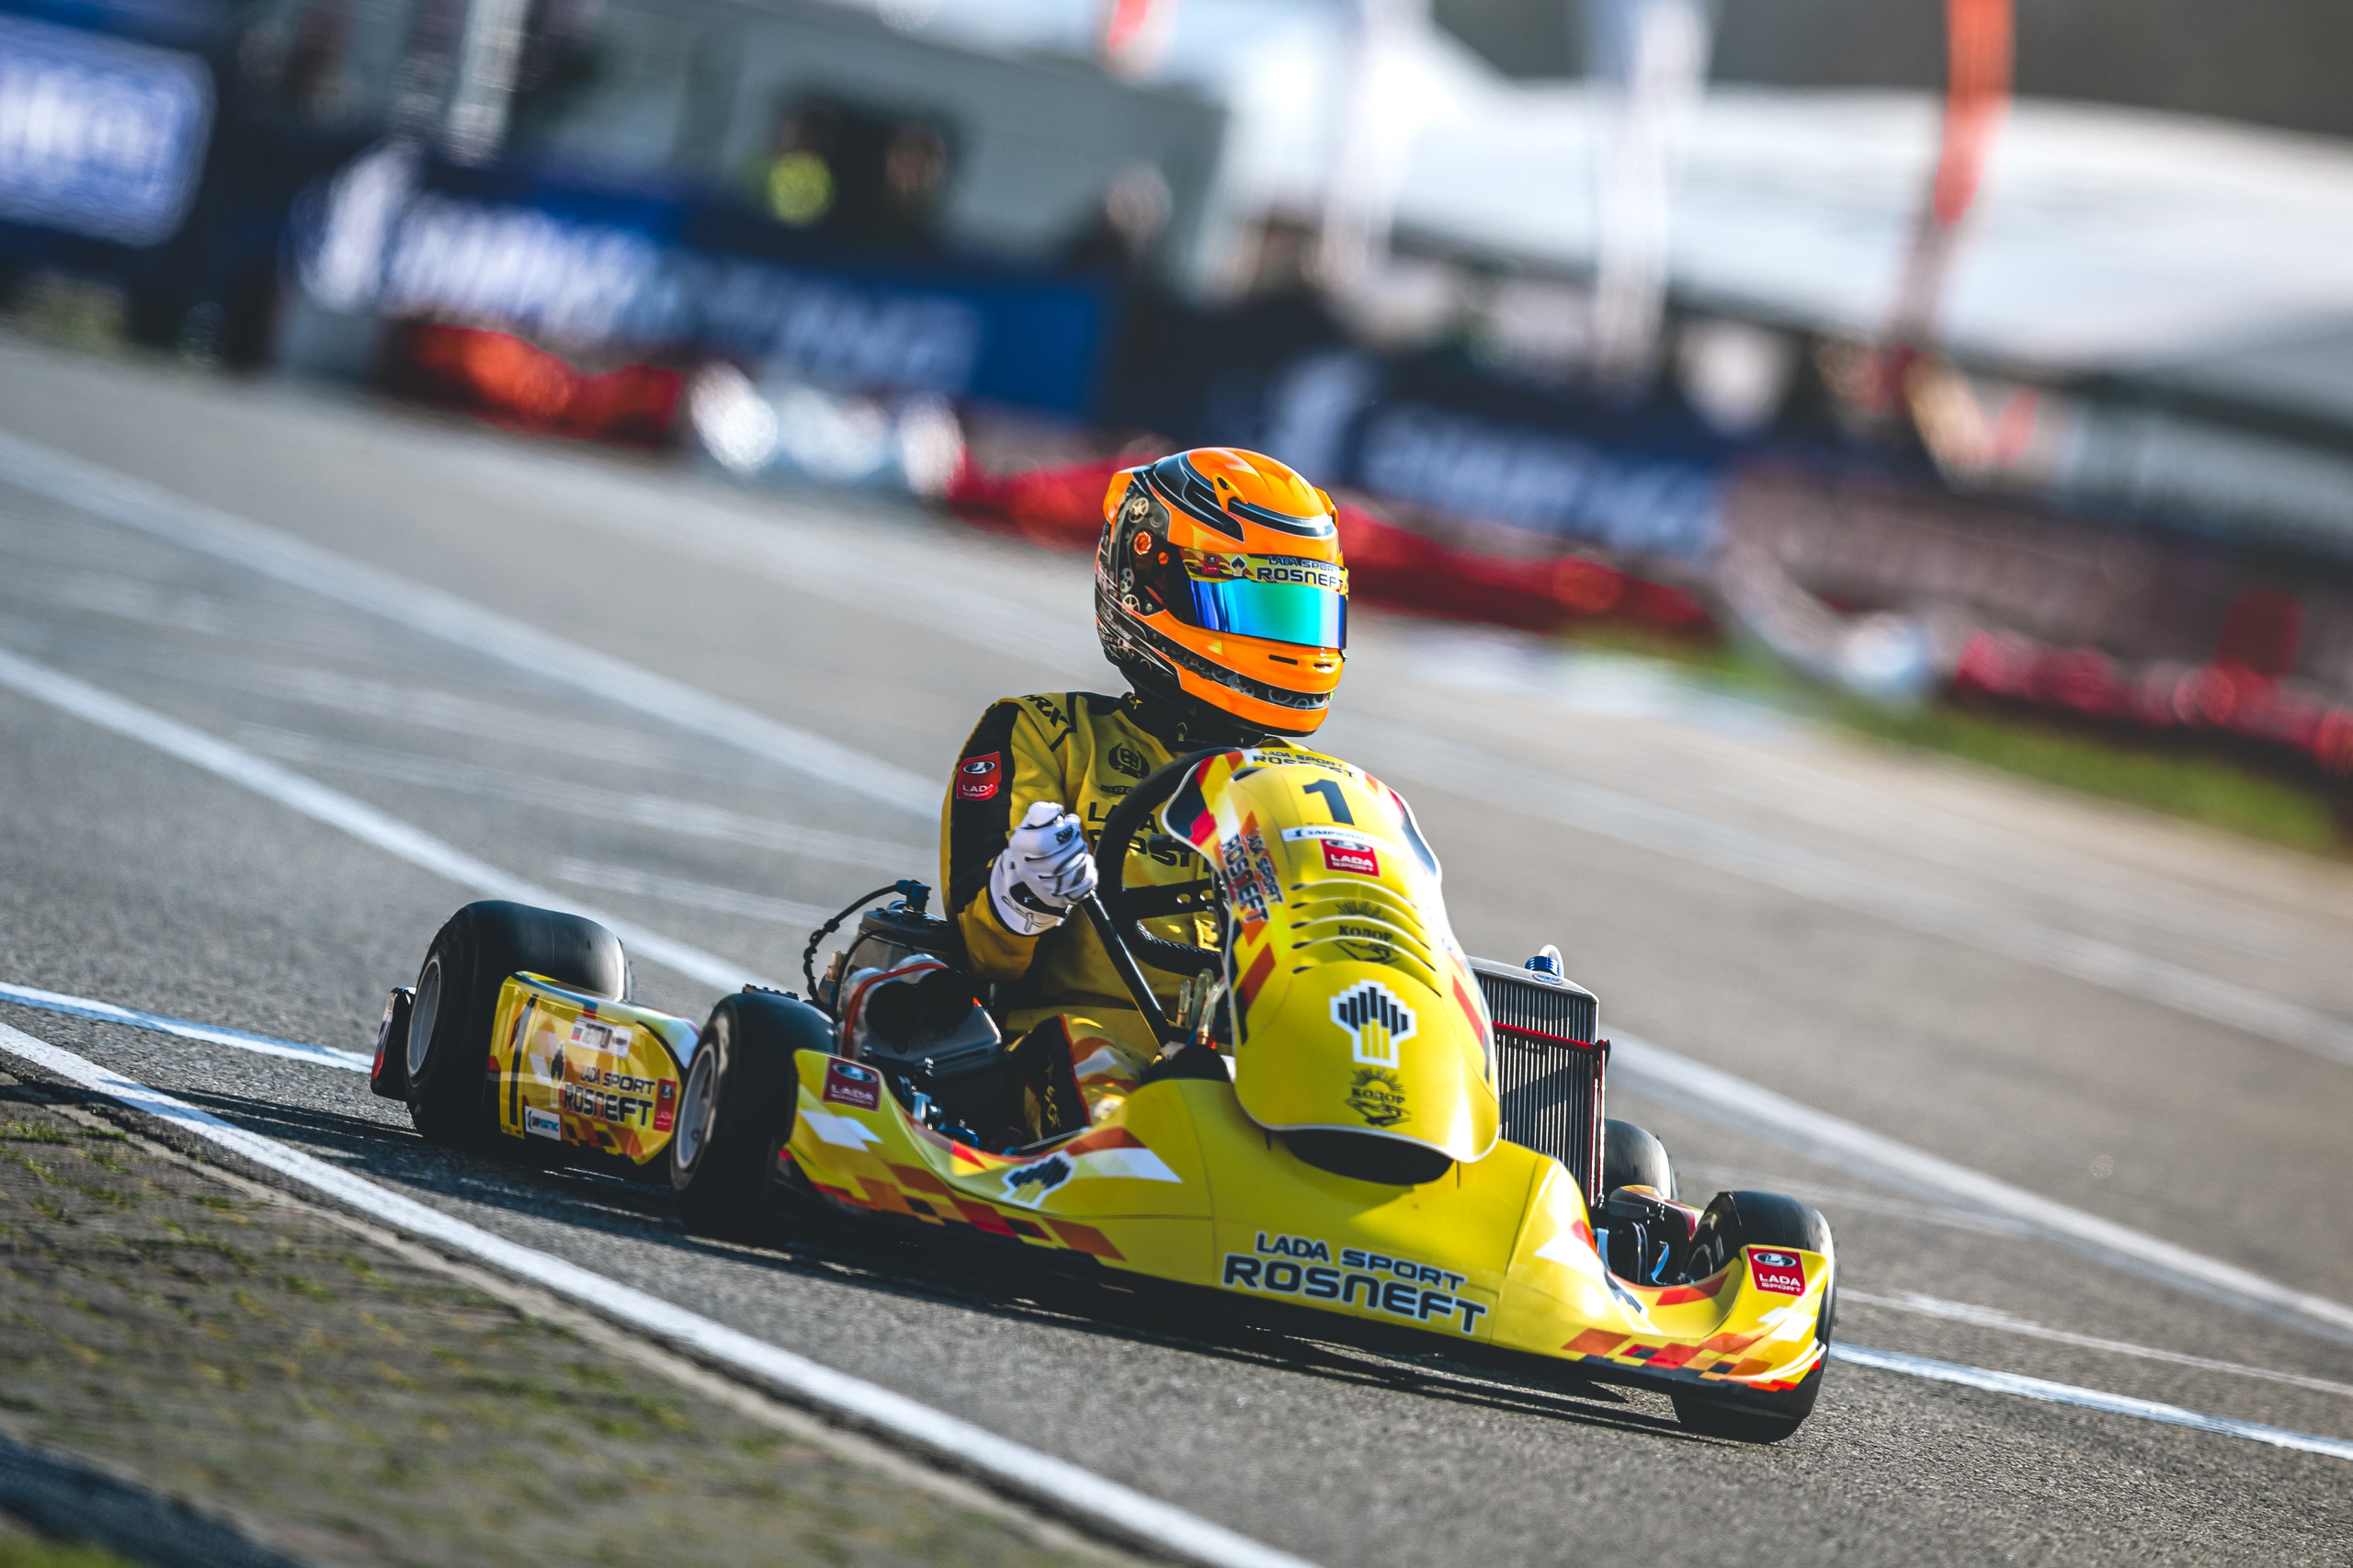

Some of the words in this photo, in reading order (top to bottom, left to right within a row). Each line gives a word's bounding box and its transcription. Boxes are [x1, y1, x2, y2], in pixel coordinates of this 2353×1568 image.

[1268, 556, 1298, 566] LADA
[1256, 567, 1343, 590] ROSNEFT
[1262, 750, 1290, 758] LADA
[1295, 754, 1345, 768] SPORT
[1302, 778, 1355, 826] 1
[1245, 827, 1266, 859] LADA
[1330, 853, 1373, 868] LADA
[1221, 833, 1269, 922] ROSNEFT
[1255, 857, 1284, 903] SPORT
[580, 1065, 600, 1084] LADA
[603, 1072, 655, 1096] SPORT
[831, 1085, 875, 1102] LADA
[563, 1083, 654, 1127] ROSNEFT
[1256, 1232, 1329, 1262] LADA
[1341, 1248, 1465, 1290] SPORT
[1222, 1254, 1487, 1334] ROSNEFT
[1758, 1273, 1801, 1287] LADA
[1761, 1282, 1801, 1292] SPORT
